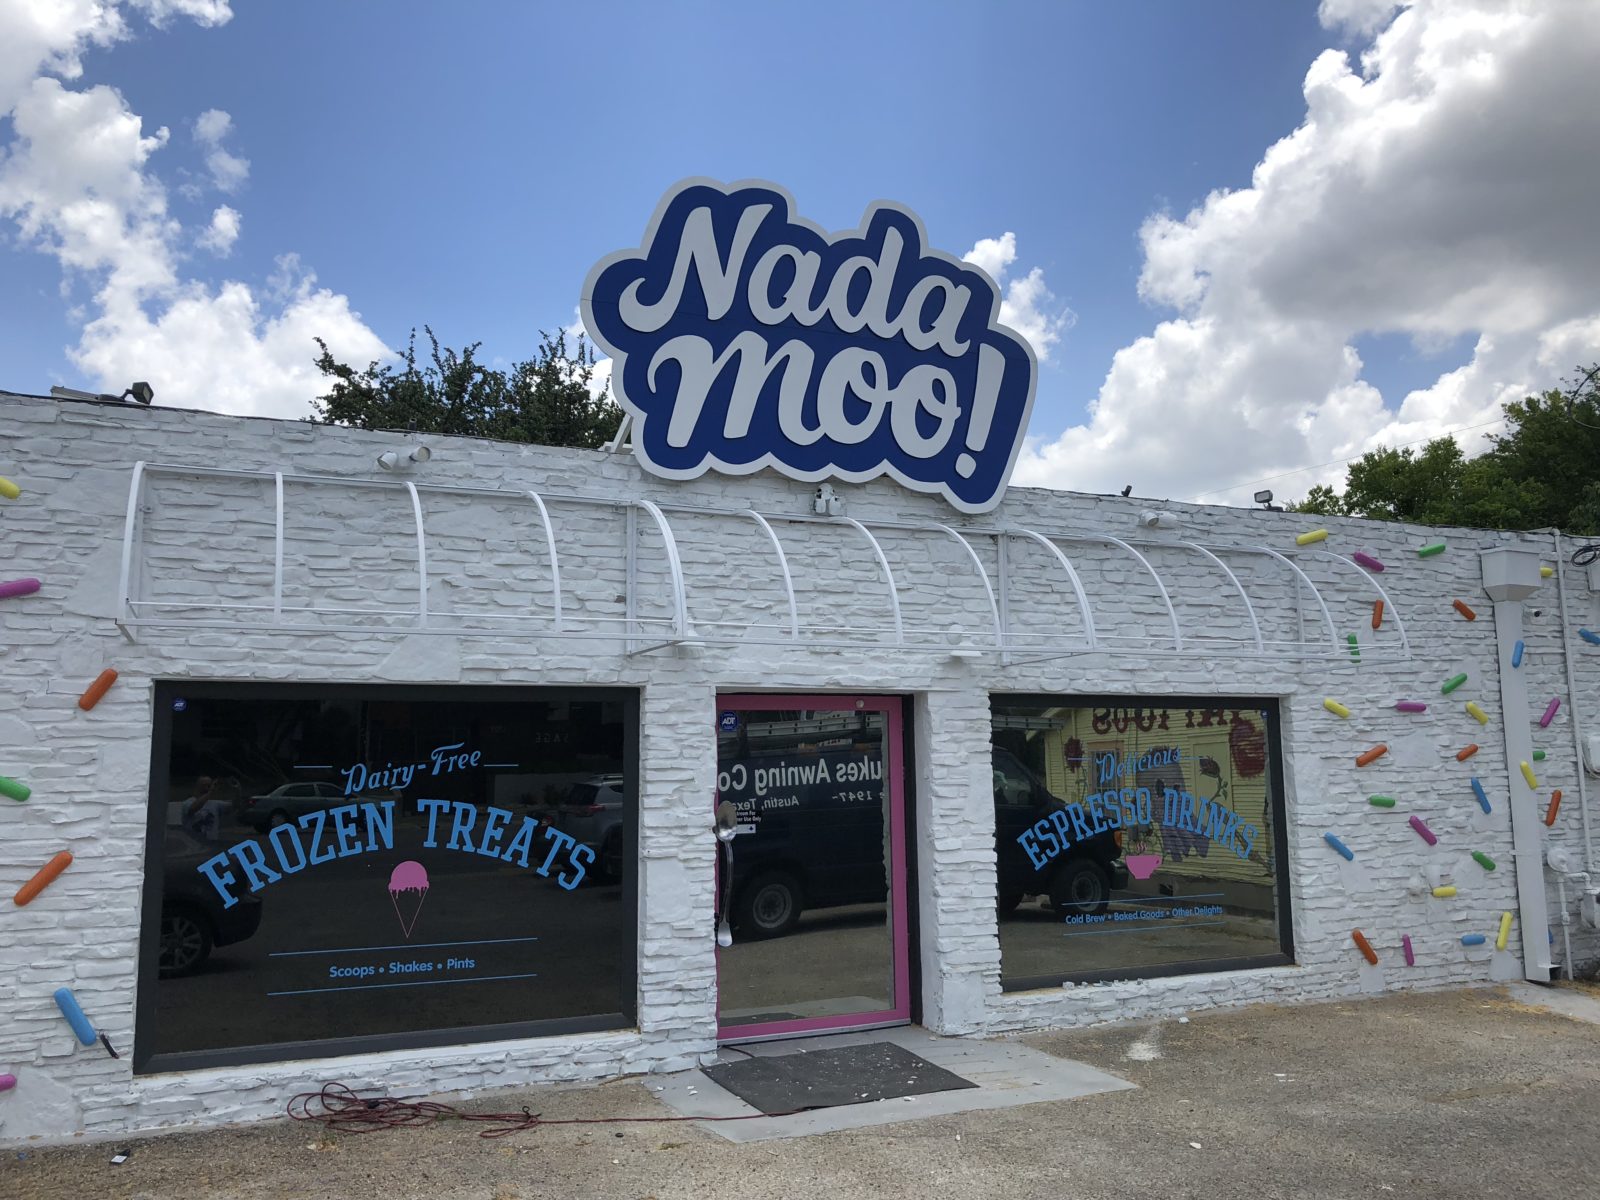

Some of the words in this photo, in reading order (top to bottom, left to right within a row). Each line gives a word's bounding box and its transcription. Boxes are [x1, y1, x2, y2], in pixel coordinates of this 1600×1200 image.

[619, 204, 971, 357] Nada
[647, 331, 1006, 479] Moo!
[341, 742, 482, 795] Dairy-Free
[1096, 744, 1182, 784] Delicious
[197, 801, 396, 909] FROZEN
[417, 799, 596, 891] TREATS
[1016, 787, 1151, 871] ESPRESSO
[1162, 788, 1258, 859] DRINKS
[1066, 914, 1083, 925] Cold
[1086, 914, 1105, 924] Brew
[1114, 911, 1138, 921] Baked
[1140, 909, 1164, 919] Goods
[1172, 907, 1192, 918] Other
[1194, 905, 1223, 917] Delights
[329, 965, 375, 978] Scoops
[389, 961, 433, 973] Shakes
[447, 957, 476, 969] Pints
